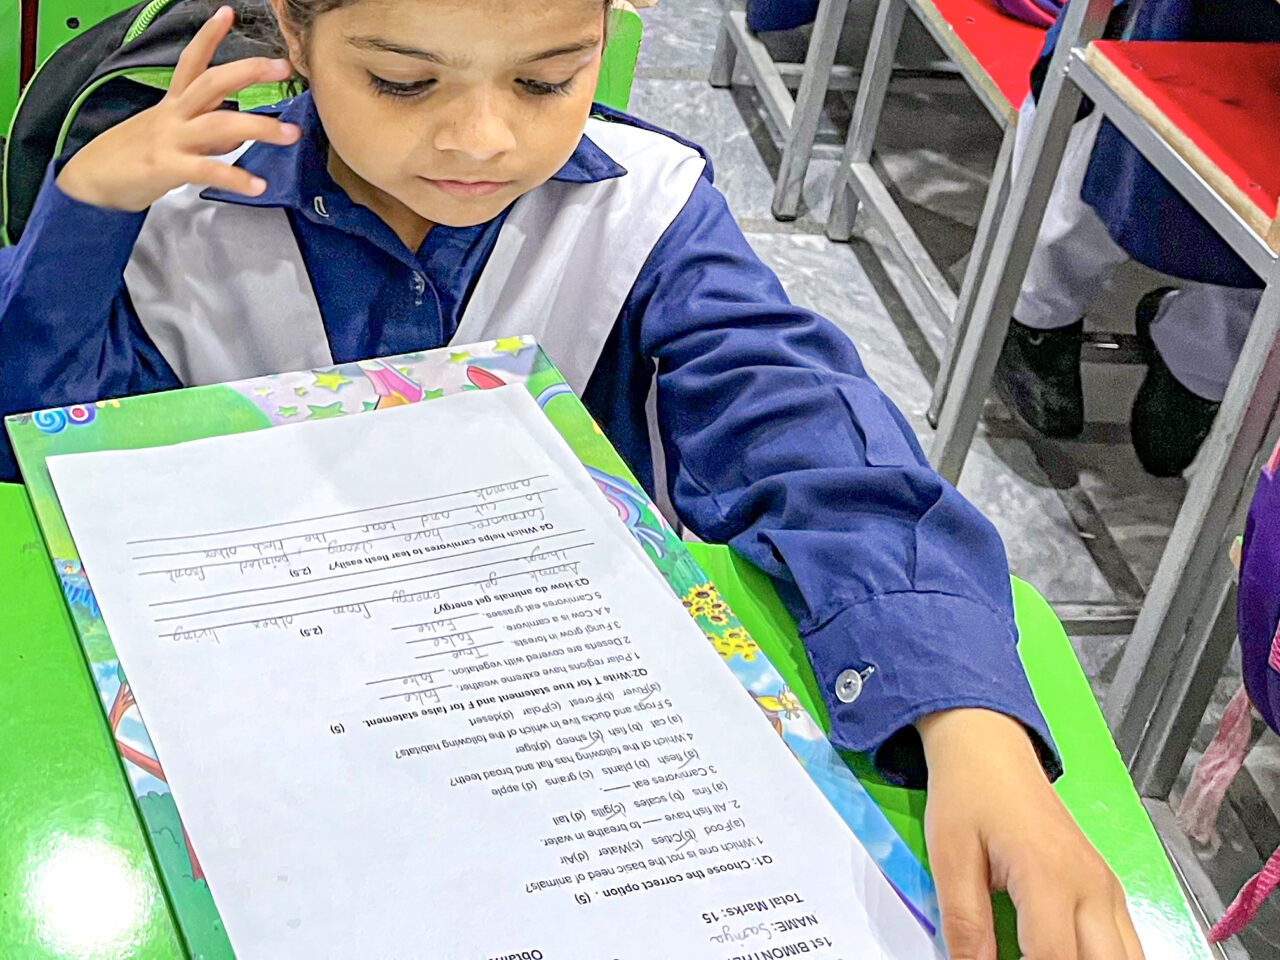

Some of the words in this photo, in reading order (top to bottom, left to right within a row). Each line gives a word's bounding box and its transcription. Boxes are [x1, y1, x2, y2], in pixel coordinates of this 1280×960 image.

[477, 532, 506, 543] helps
[424, 538, 476, 553] carnivores
[364, 554, 390, 565] flesh
[391, 550, 412, 559] tear
[328, 558, 363, 571] easily?
[289, 566, 312, 578] (2.5)
[493, 588, 533, 602] animals
[534, 585, 549, 594] do
[474, 594, 492, 606] get
[433, 600, 474, 615] energy?
[524, 603, 541, 612] eat
[571, 609, 594, 619] Cow
[299, 625, 323, 638] (2.5)
[559, 626, 584, 638] grow
[525, 648, 565, 663] covered
[566, 645, 583, 654] are
[503, 656, 525, 667] with
[567, 658, 605, 671] regions
[500, 670, 541, 684] extreme
[542, 666, 568, 676] have
[552, 681, 576, 691] true
[576, 678, 593, 687] for
[594, 676, 603, 686] T
[497, 686, 551, 703] statement
[568, 691, 615, 708] (b)Forest
[449, 702, 466, 711] for
[468, 700, 476, 710] F
[475, 696, 497, 708] and
[420, 705, 448, 716] false
[522, 701, 562, 716] (c)Polar
[612, 706, 633, 718] and
[362, 711, 419, 728] statement.
[468, 709, 515, 727] (d)desert
[561, 716, 581, 726] live
[581, 710, 612, 722] ducks
[666, 713, 683, 725] (a)
[329, 722, 346, 735] (5)
[518, 722, 549, 735] which
[549, 720, 562, 729] in
[627, 721, 644, 733] (b)
[649, 718, 667, 729] cat
[488, 730, 506, 740] the
[506, 728, 518, 739] of
[588, 729, 604, 742] (c)
[607, 726, 628, 737] fish
[441, 734, 488, 749] following
[555, 733, 588, 746] sheep
[640, 740, 652, 750] of
[395, 743, 442, 760] habitats?
[515, 739, 552, 754] (d)tiger
[622, 742, 641, 752] the
[574, 746, 622, 761] following
[657, 753, 684, 765] flesh
[683, 748, 700, 762] (a)
[535, 759, 554, 770] flat
[554, 755, 576, 765] has
[633, 758, 651, 770] (b)
[482, 767, 515, 780] broad
[514, 762, 535, 774] and
[601, 761, 634, 775] plants
[450, 772, 482, 787] teeth?
[544, 771, 578, 786] grains
[578, 769, 594, 781] (c)
[491, 784, 520, 797] apple
[521, 779, 538, 792] (d)
[631, 779, 651, 790] eat
[711, 780, 729, 793] (a)
[668, 789, 685, 802] (b)
[691, 786, 713, 796] fins
[633, 795, 668, 808] scales
[712, 802, 727, 813] All
[569, 809, 587, 823] (d)
[664, 810, 693, 822] have
[691, 806, 713, 817] fish
[552, 814, 571, 826] tail
[629, 820, 642, 829] to
[586, 823, 629, 838] breathe
[703, 817, 746, 836] (a)Food
[540, 834, 574, 847] water.
[574, 831, 586, 840] in
[598, 839, 644, 857] (c)Water
[698, 845, 720, 856] one
[559, 850, 590, 865] (d)Air
[665, 850, 686, 864] not
[686, 850, 697, 859] is
[751, 855, 771, 866] Q1:
[616, 861, 648, 873] basic
[647, 856, 667, 867] the
[706, 860, 751, 875] Choose
[574, 873, 586, 885] of
[587, 867, 616, 881] need
[685, 869, 706, 880] the
[525, 875, 573, 894] animals?
[641, 874, 684, 891] correct
[602, 882, 640, 898] option
[574, 891, 592, 906] (5)
[768, 892, 805, 909] Total
[720, 900, 769, 918] Marks:
[701, 911, 720, 924] 15
[770, 914, 819, 933] NAME:
[809, 936, 833, 950] 1st
